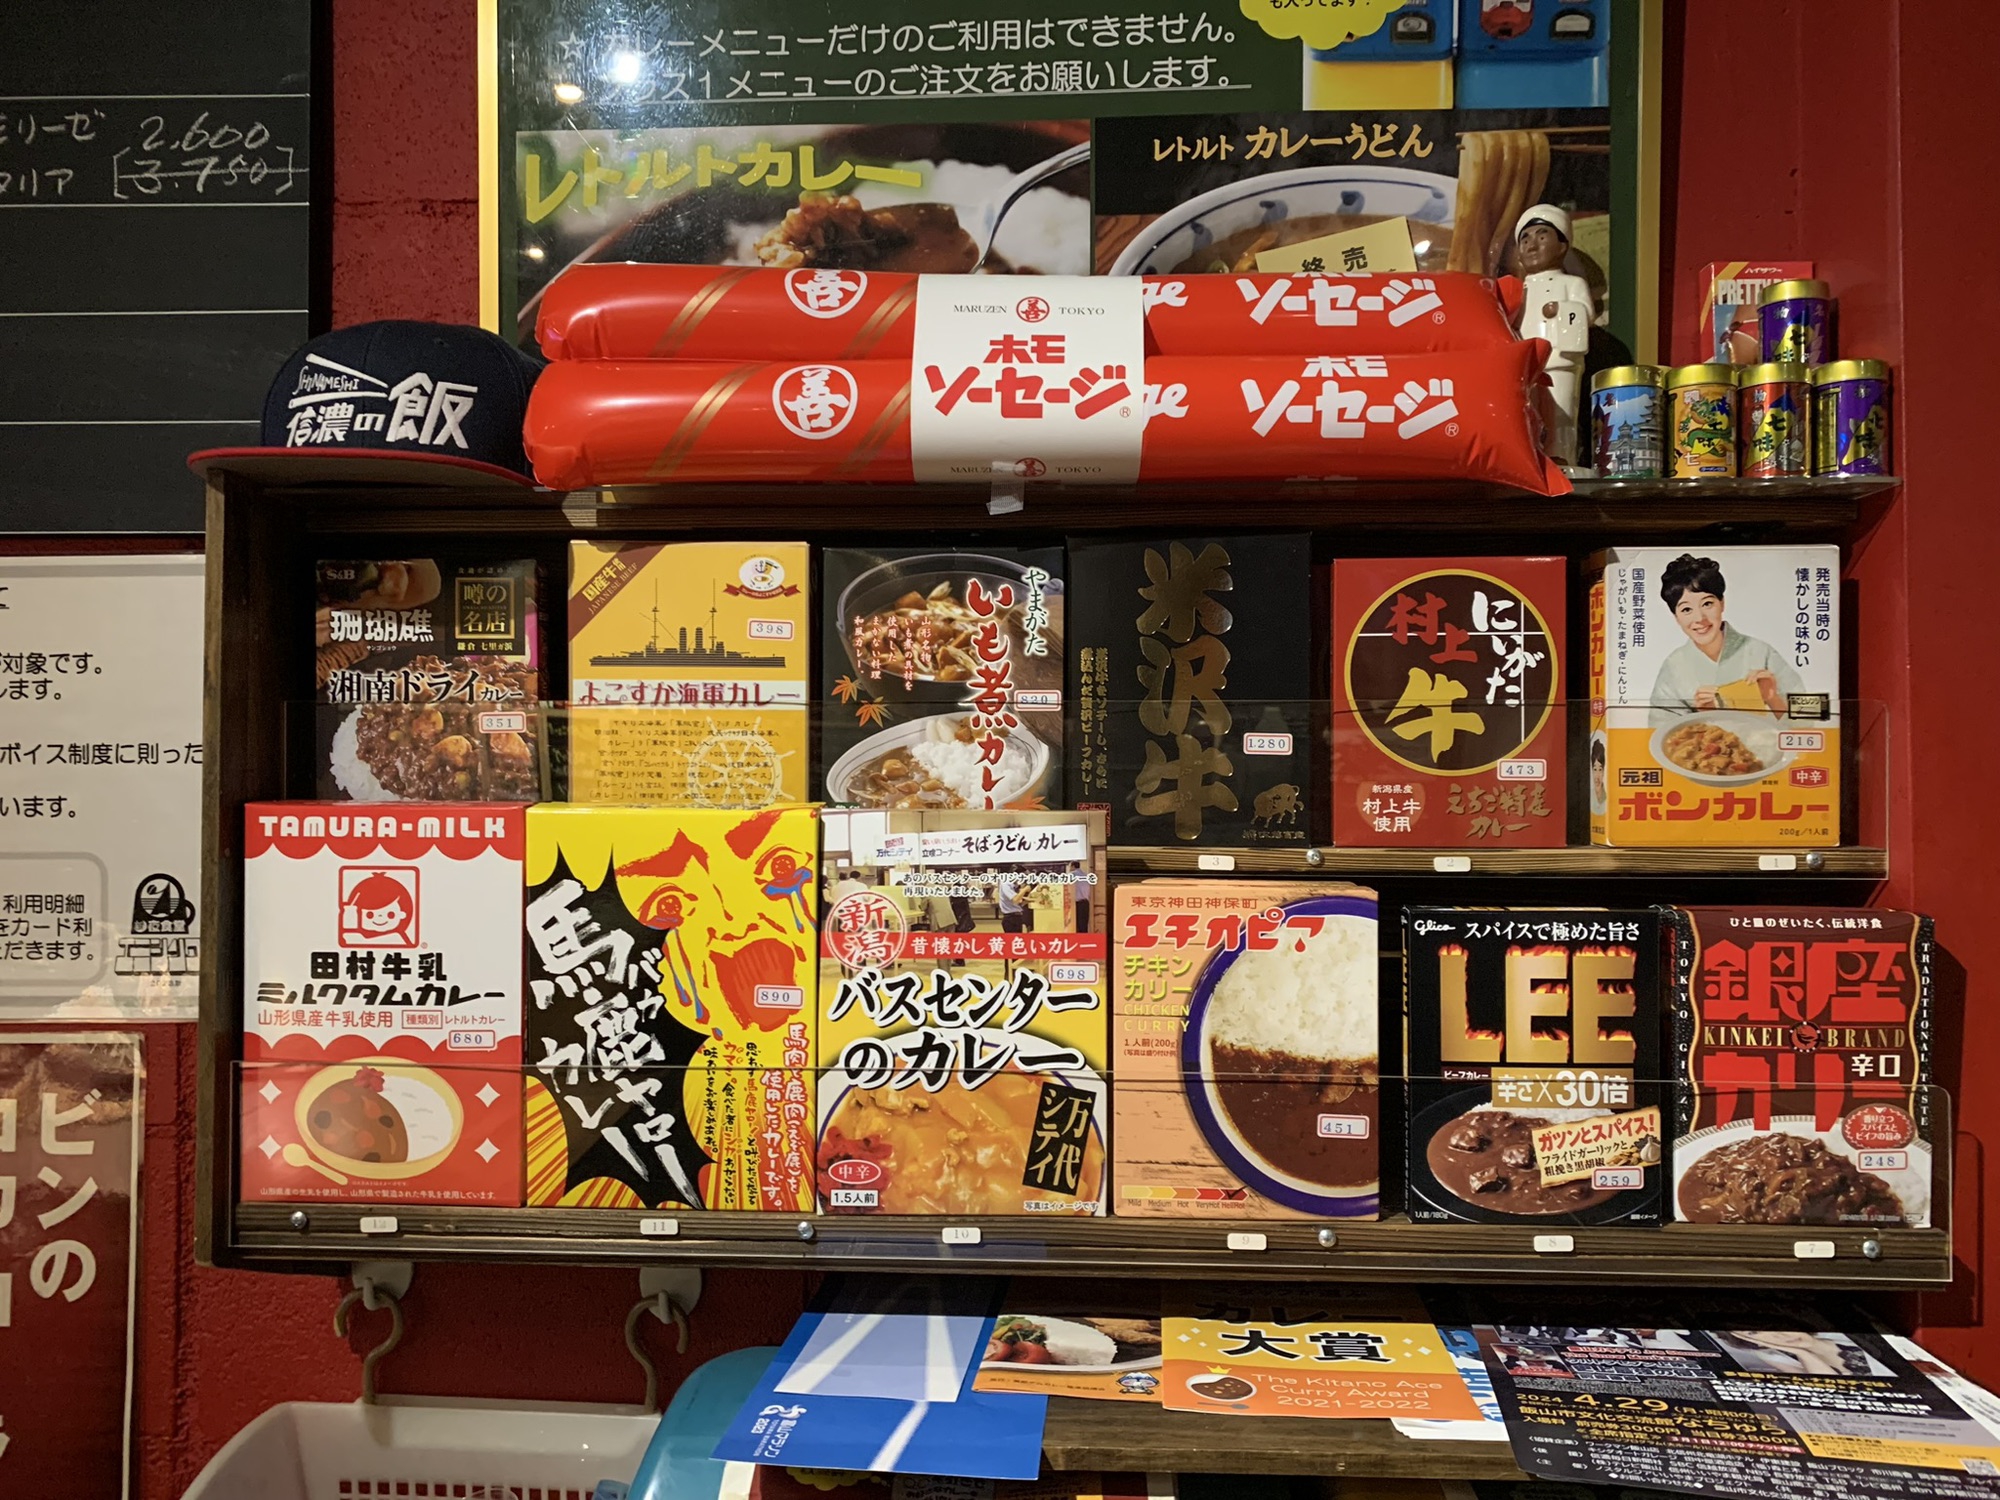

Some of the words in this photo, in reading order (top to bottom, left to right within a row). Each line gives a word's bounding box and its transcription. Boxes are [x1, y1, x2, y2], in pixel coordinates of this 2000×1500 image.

[1152, 136, 1234, 162] レトルト
[1244, 125, 1434, 161] カレーうどん
[524, 141, 922, 222] レトルトカレー
[953, 304, 1007, 314] MARUZEN
[1058, 307, 1105, 316] TOKYO
[1235, 278, 1444, 328] ソーセージ
[983, 334, 1066, 364] ホモ
[1301, 355, 1389, 377] ホモ
[292, 364, 360, 396] SHINAMESHI
[924, 364, 1131, 420] ソーセージ
[1240, 378, 1459, 439] ソーセージ
[1055, 465, 1102, 474] TOKYO
[326, 570, 355, 580] S&B
[463, 584, 507, 606] 噂の
[588, 579, 622, 615] JAPANESE
[1815, 567, 1830, 642] 発売当時の
[1025, 568, 1047, 656] やまがた
[1631, 567, 1645, 648] 国産野菜使用
[1795, 567, 1810, 668] 懐かしの味わい
[330, 611, 434, 643] 珊瑚礁
[463, 611, 506, 633] 名店
[756, 622, 784, 635] 398
[887, 616, 898, 663] 使用した
[1472, 590, 1546, 708] にいがた
[578, 681, 801, 709] よこすか海軍カレー
[1020, 694, 1049, 706] 820
[1135, 541, 1240, 840] 米沢牛
[485, 718, 514, 729] 351
[1786, 735, 1815, 747] 216
[1505, 764, 1535, 775] 473
[1621, 771, 1660, 784] 元祖
[1796, 769, 1823, 783] 中辛
[1371, 783, 1414, 795] 新潟県産
[1362, 798, 1422, 815] 村上牛
[1618, 791, 1830, 821] ボンカレー
[259, 816, 506, 839] TAMURA-MILK
[1373, 816, 1412, 833] 使用
[1466, 820, 1532, 840] カレー
[903, 886, 985, 898] 再現いたしました。
[1131, 896, 1258, 910] 東京神田神保町
[3, 893, 85, 914] 利用明細
[839, 898, 894, 964] 新潟
[1124, 907, 1327, 954] エチオピア
[1465, 922, 1640, 942] スパイスで極めた旨さ
[1729, 917, 1883, 929] ひと皿のぜいたく、伝統洋食
[911, 936, 1098, 956] 昔懐かし黄色いカレー
[311, 951, 448, 982] 田村牛乳
[1056, 968, 1086, 980] 698
[1123, 955, 1193, 977] チキン
[1123, 979, 1193, 1001] カリー
[1679, 940, 1690, 1020] TOKYO
[1703, 939, 1906, 1022] 銀座
[257, 982, 506, 1008] ミルクタムカレー
[760, 989, 791, 1003] 890
[830, 972, 1094, 1026] バスセンター
[1439, 946, 1637, 1064] LEE
[1920, 942, 1931, 1063] TRADITIONAL
[258, 1010, 393, 1028] 山形県産牛乳使用
[444, 1015, 507, 1026] レトルトカレー
[1123, 1003, 1190, 1016] CHICKEN
[1123, 1019, 1190, 1032] CURRY
[1703, 1025, 1784, 1047] KINKEI
[1827, 1026, 1906, 1048] BRAND
[452, 1032, 483, 1044] 680
[843, 1031, 1081, 1085] のカレー
[1851, 1054, 1901, 1077] 辛口
[1679, 1042, 1689, 1122] GINZA
[1920, 1072, 1931, 1127] TASTE
[1323, 1121, 1354, 1135] 451
[1052, 1096, 1093, 1191] 万代
[838, 1164, 870, 1180] 中辛
[1864, 1155, 1896, 1167] 248
[1599, 1175, 1631, 1187] 259
[30, 1088, 103, 1302] ビンの
[833, 1192, 876, 1204] 1.5人前
[1127, 1199, 1143, 1207] Mild
[1147, 1199, 1173, 1208] Medium
[1176, 1200, 1190, 1208] Hot
[1221, 1329, 1394, 1363] 大賞
[1251, 1373, 1298, 1386] The
[1305, 1377, 1388, 1390] Kitano
[1394, 1380, 1444, 1390] Ace
[1269, 1384, 1342, 1399] Curry
[1350, 1388, 1431, 1400] Award
[1276, 1396, 1432, 1411] 2021-2022
[1516, 1392, 1563, 1402] 2024
[1573, 1393, 1670, 1412] 4.29
